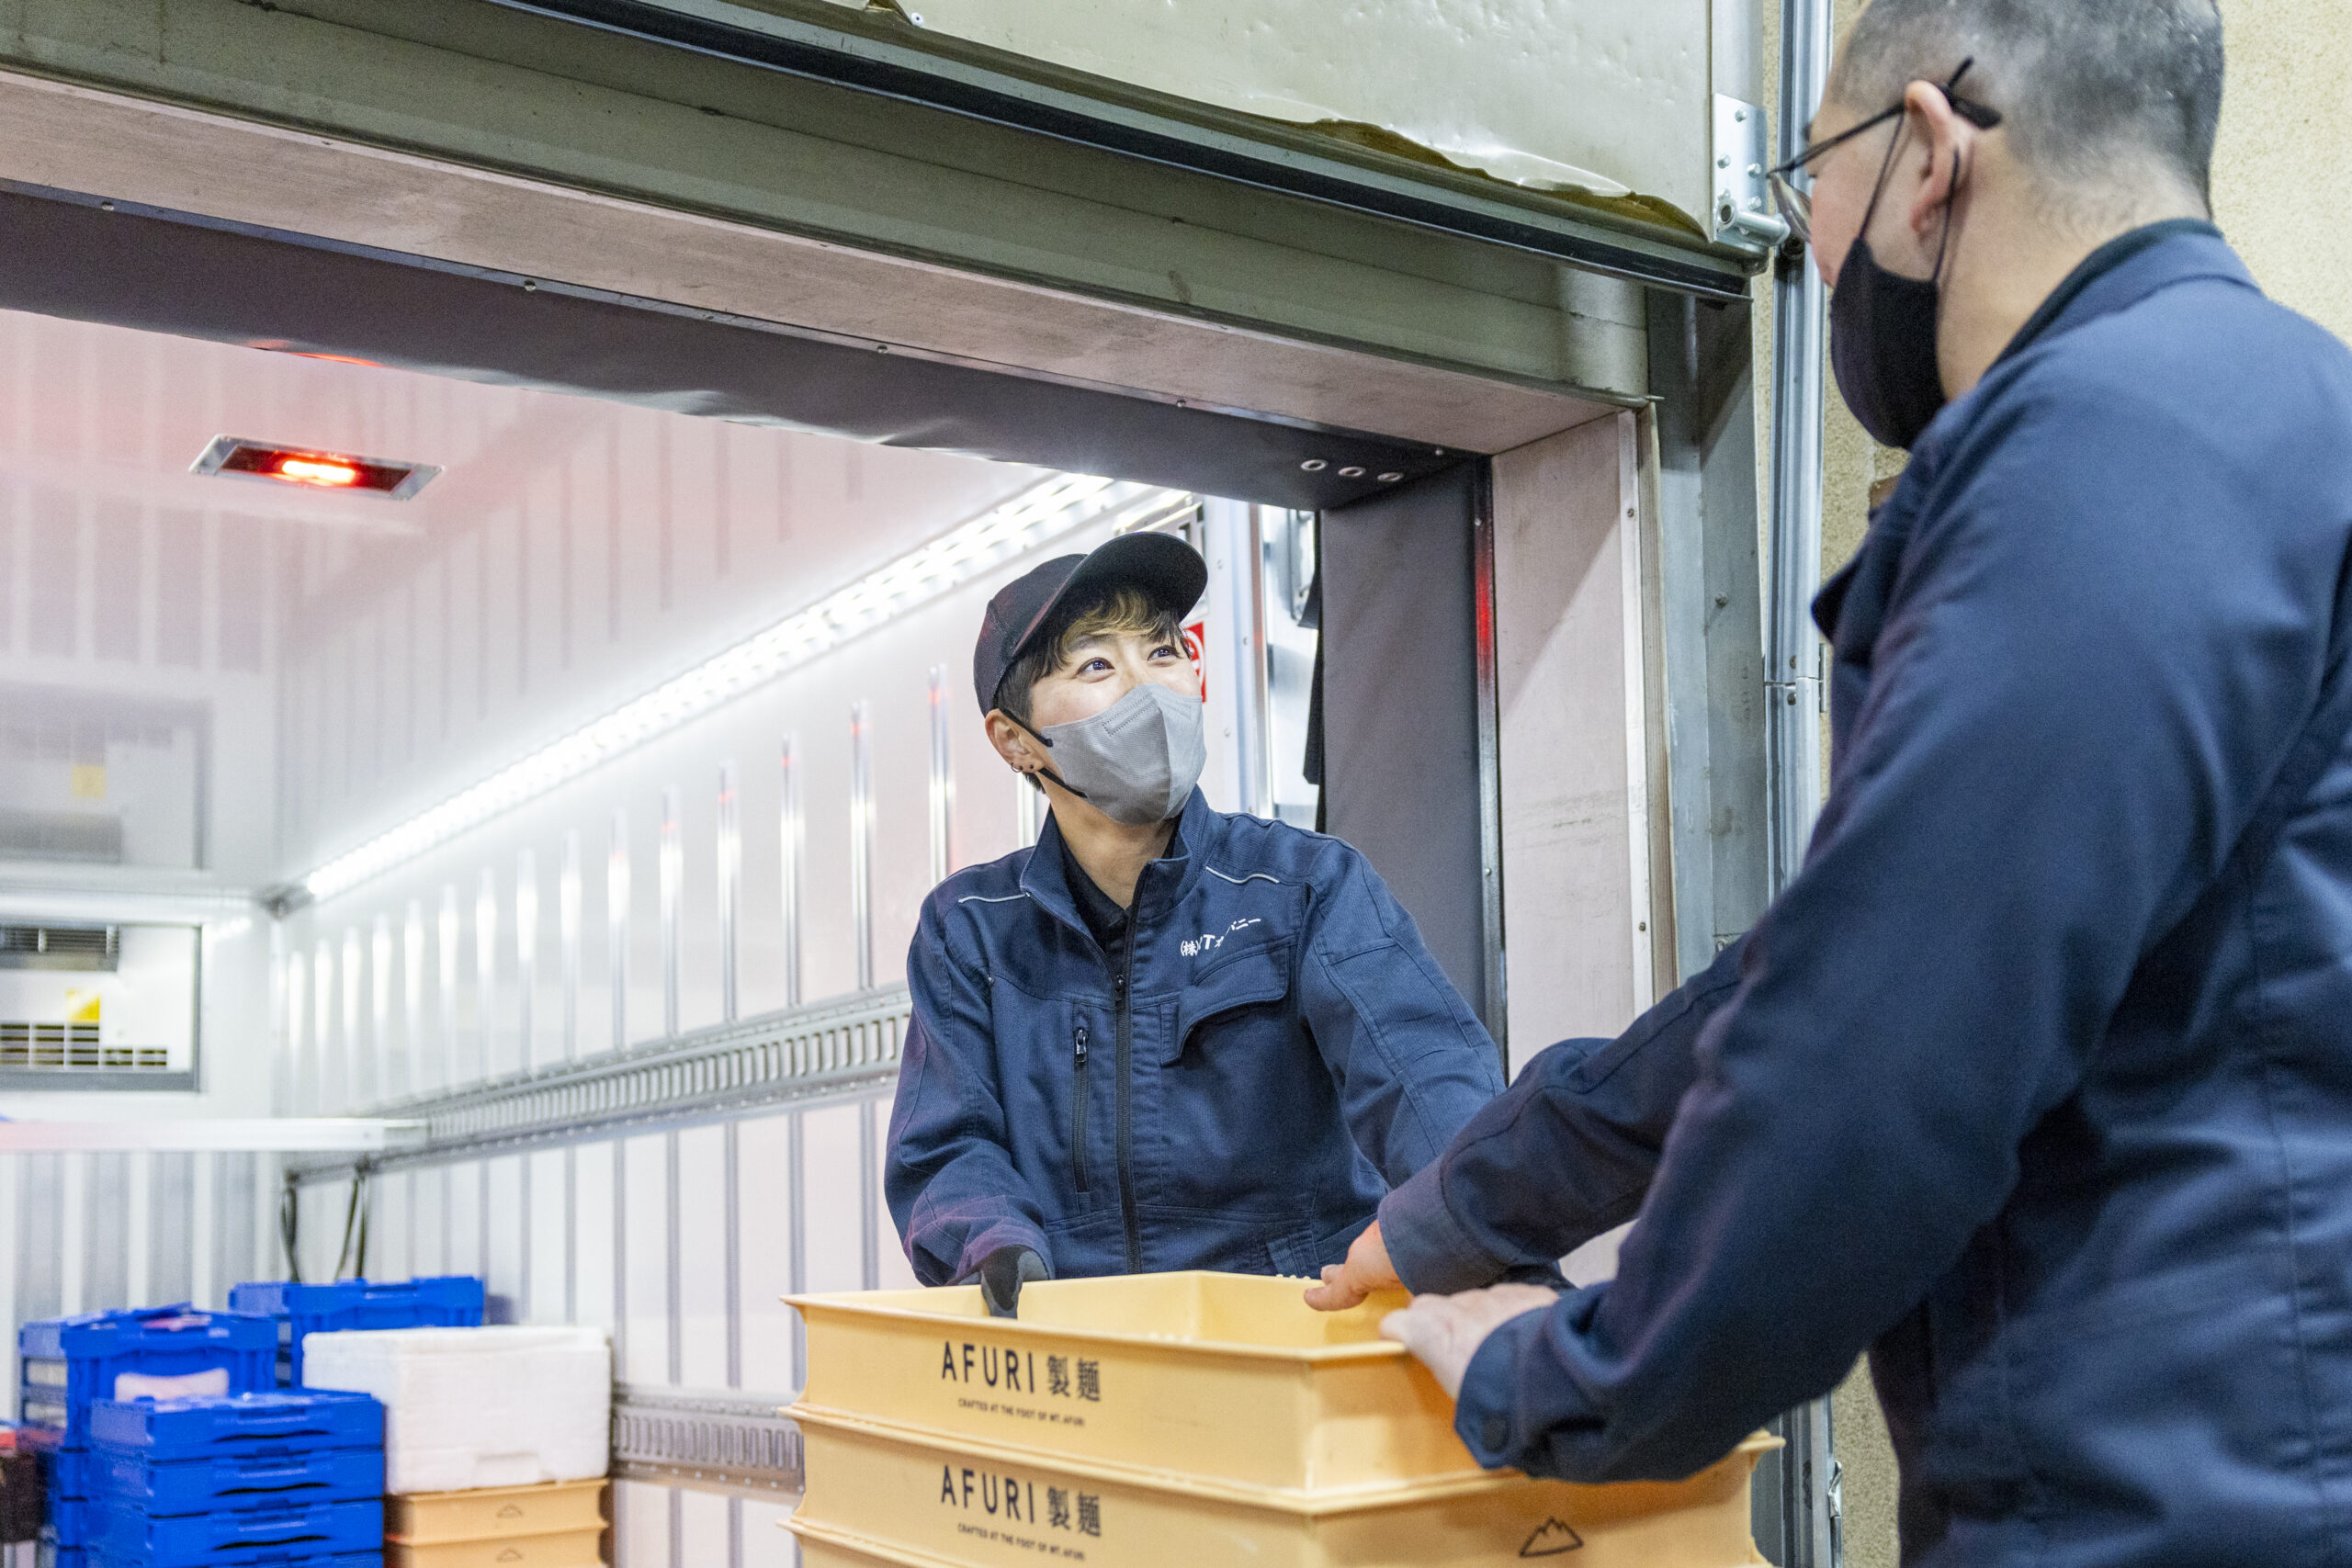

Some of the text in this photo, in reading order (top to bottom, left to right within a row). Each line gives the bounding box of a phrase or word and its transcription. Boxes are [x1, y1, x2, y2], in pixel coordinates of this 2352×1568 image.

[942, 1341, 1101, 1402] AFURI 製麺
[941, 1464, 1101, 1538] AFURI 製麺
